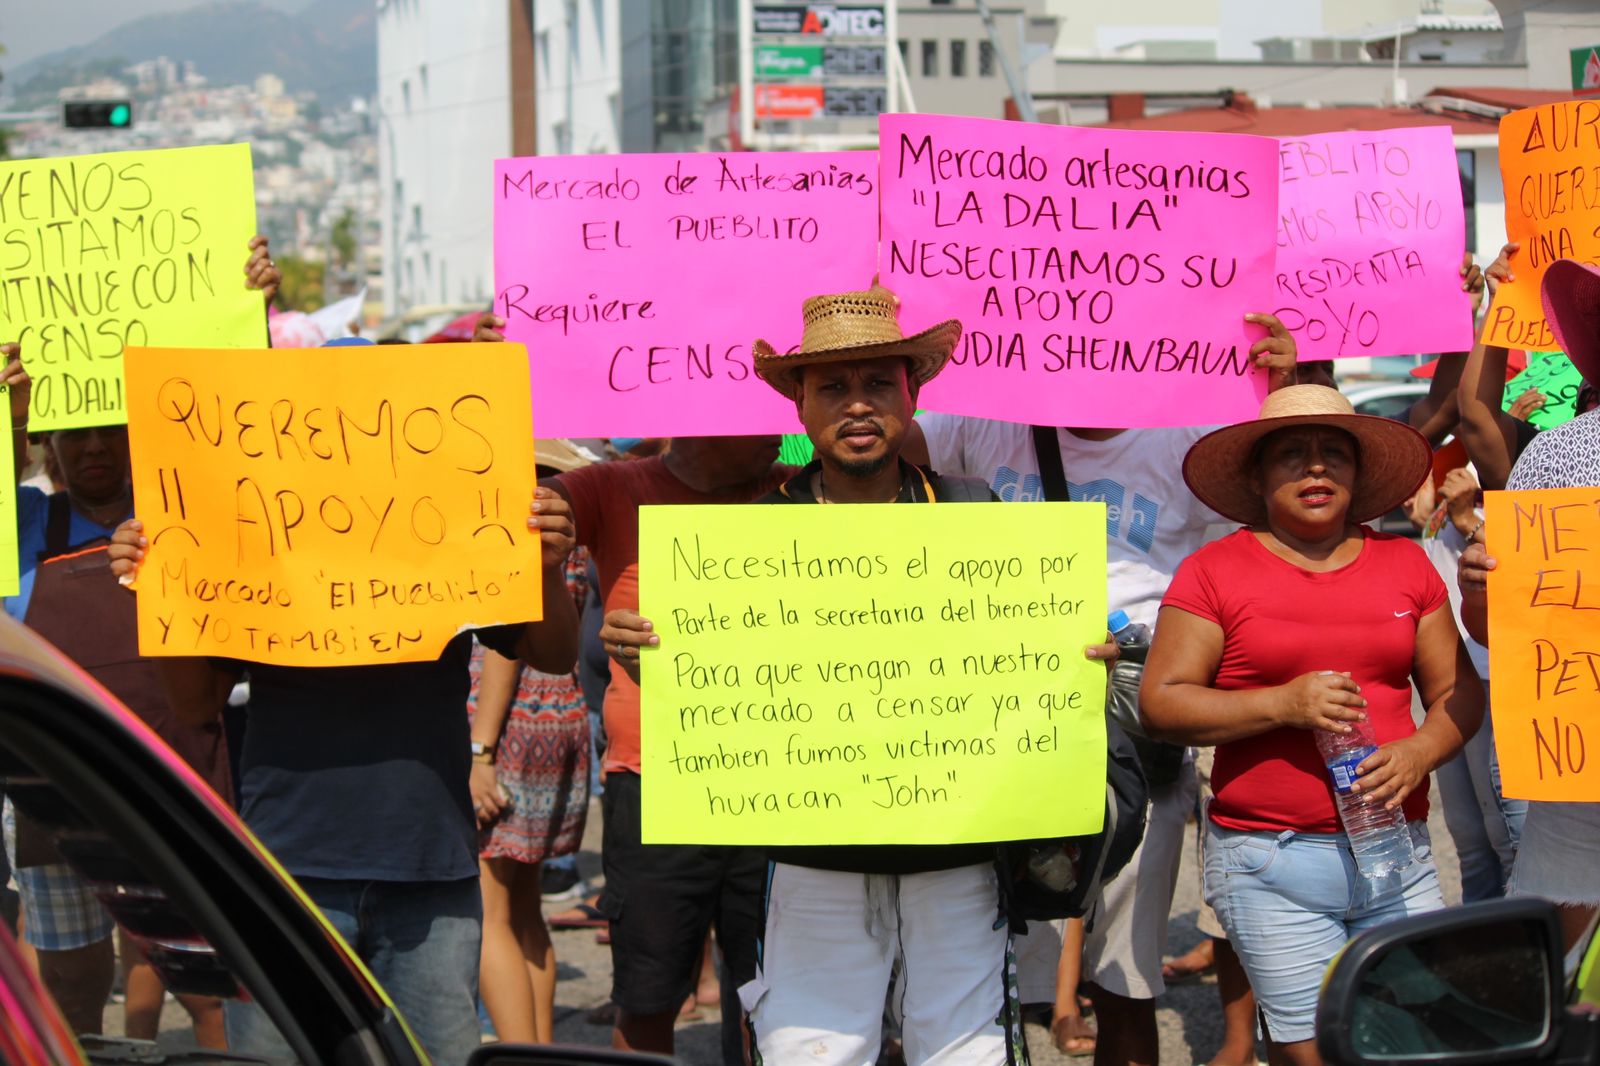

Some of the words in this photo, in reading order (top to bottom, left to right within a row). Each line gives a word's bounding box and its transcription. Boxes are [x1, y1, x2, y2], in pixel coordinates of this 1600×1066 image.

[503, 167, 640, 201] Mercado
[664, 160, 698, 195] de
[714, 157, 873, 196] Artesanias
[898, 132, 1048, 186] Mercado
[1065, 147, 1251, 199] artesanias
[1280, 140, 1411, 183] EBLITO
[582, 220, 632, 251] EL
[668, 214, 819, 243] PUEBLITO
[912, 187, 984, 229] "LA
[1003, 191, 1178, 233] DALIA"
[1354, 186, 1443, 235] APOYO
[3, 206, 201, 271] SITAMOS
[1529, 227, 1575, 269] UNA
[890, 240, 1166, 285] NESECITAMOS
[1180, 254, 1237, 289] SU
[1276, 246, 1427, 298] RESIDENTA
[499, 284, 656, 336] Requiere
[982, 285, 1114, 325] APOYO
[608, 343, 801, 393] CENS
[157, 377, 494, 480] QUEREMOS
[236, 477, 446, 568] APOYO
[161, 559, 292, 608] Mercado
[672, 532, 888, 582] Necesitamos
[906, 546, 928, 578] el
[948, 556, 1023, 588] apoyo
[1039, 552, 1079, 585] por
[157, 614, 175, 646] Y
[191, 613, 231, 649] YO
[671, 603, 732, 636] Parte
[742, 605, 771, 629] de
[778, 598, 800, 626] la
[814, 597, 925, 628] secretaria
[940, 597, 976, 623] del
[986, 592, 1085, 621] bienestar
[673, 651, 742, 690] Para
[755, 662, 804, 698] que
[816, 656, 911, 695] vengan
[929, 656, 946, 677] a
[962, 641, 1061, 676] nuestro
[679, 699, 813, 734] mercado
[837, 701, 855, 723] a
[875, 692, 974, 717] censar
[990, 693, 1021, 733] ya
[1037, 689, 1083, 714] que
[668, 739, 769, 776] tambien
[784, 732, 867, 766] fuimos
[885, 729, 997, 760] victimas
[1017, 724, 1058, 755] del
[1532, 716, 1586, 781] NO
[705, 786, 842, 817] huracan
